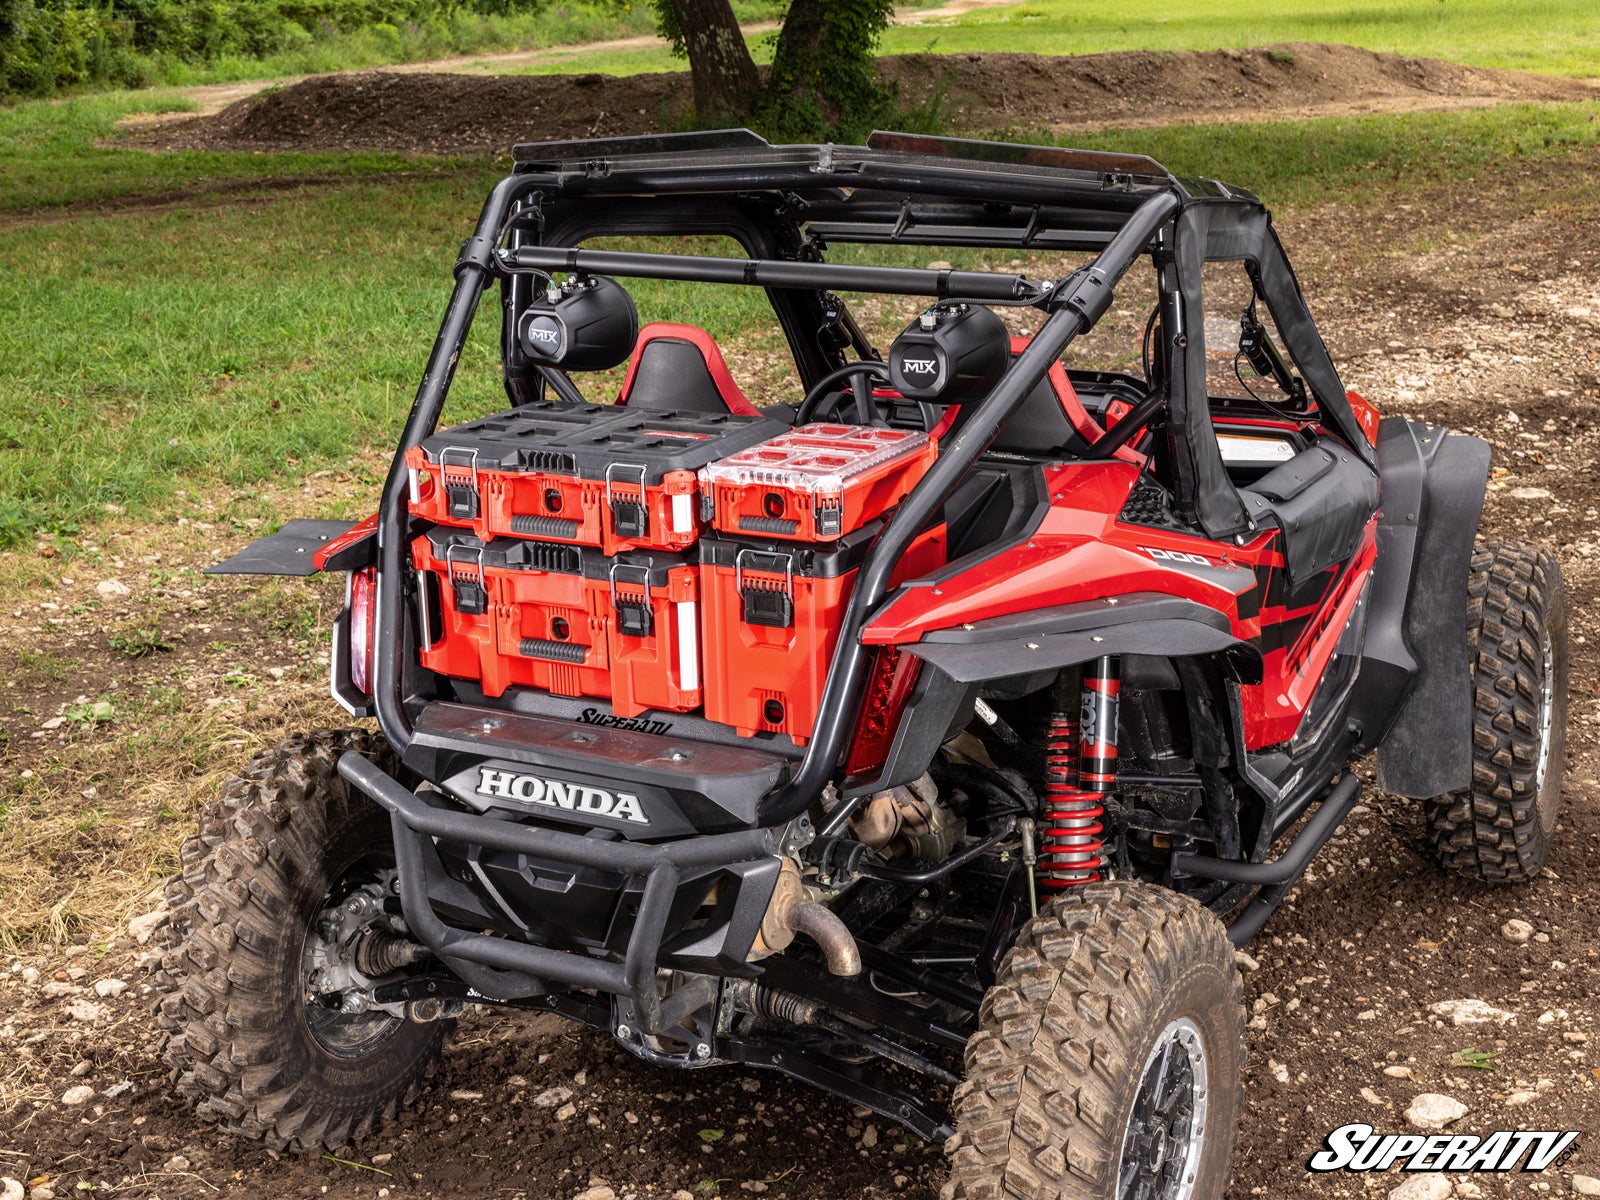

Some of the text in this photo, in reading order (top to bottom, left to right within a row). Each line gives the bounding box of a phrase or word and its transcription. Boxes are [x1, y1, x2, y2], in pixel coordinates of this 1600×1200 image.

[531, 327, 557, 344] MTX
[902, 359, 936, 374] MTX
[476, 767, 650, 824] HONDA
